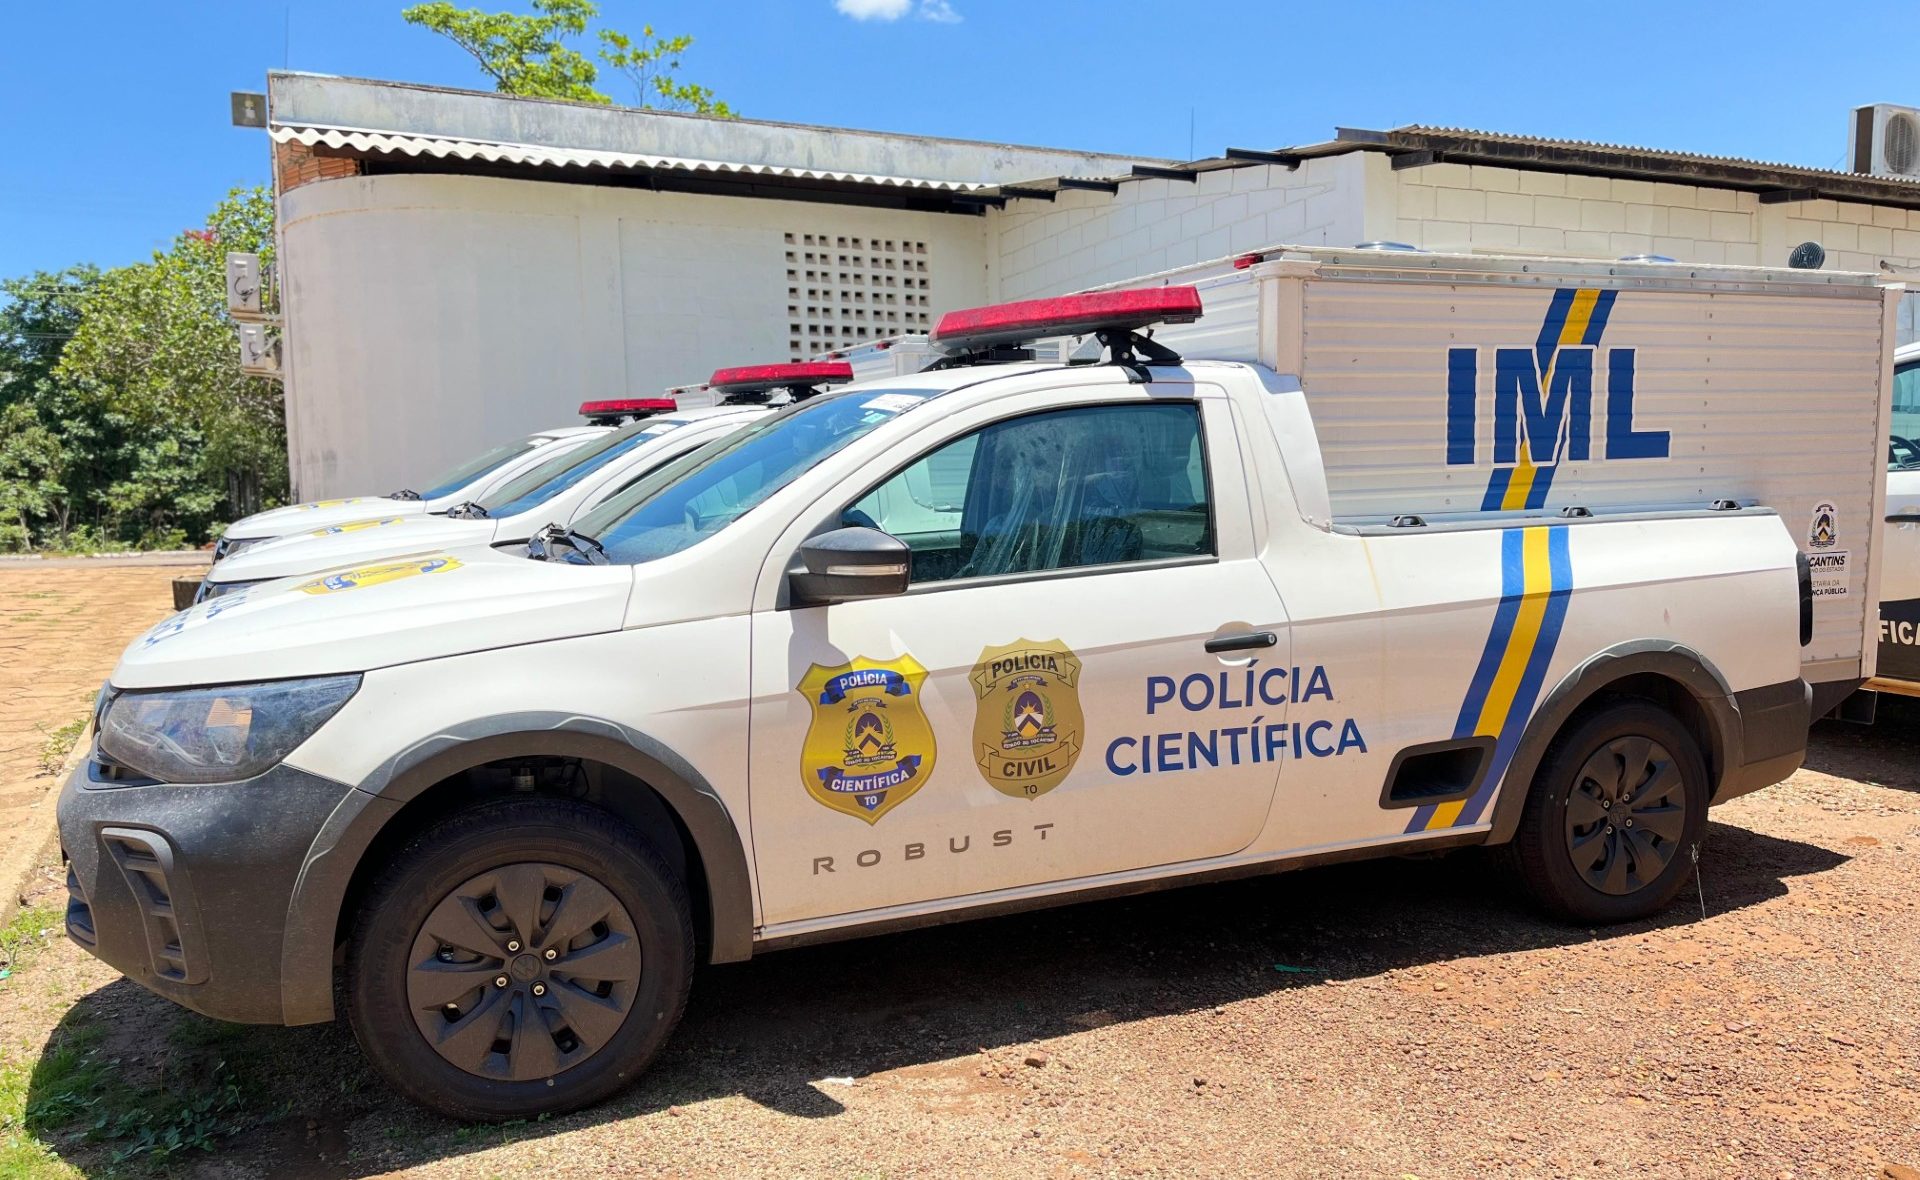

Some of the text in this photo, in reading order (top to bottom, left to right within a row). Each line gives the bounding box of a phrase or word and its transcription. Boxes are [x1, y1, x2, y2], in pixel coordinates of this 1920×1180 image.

[1446, 348, 1670, 465] IML
[1825, 587, 1847, 595] PÚBLICA
[1879, 620, 1920, 645] FIC
[992, 652, 1059, 679] POLÍCIA
[840, 671, 888, 690] POLÍCIA
[1147, 659, 1335, 715] POLÍCIA
[1105, 715, 1368, 776] CIENTÍFICA
[1003, 756, 1056, 777] CIVIL
[831, 769, 910, 791] CIENTÍFICA
[1023, 784, 1038, 795] TO
[864, 795, 878, 806] TO
[813, 823, 1054, 875] ROBUST
